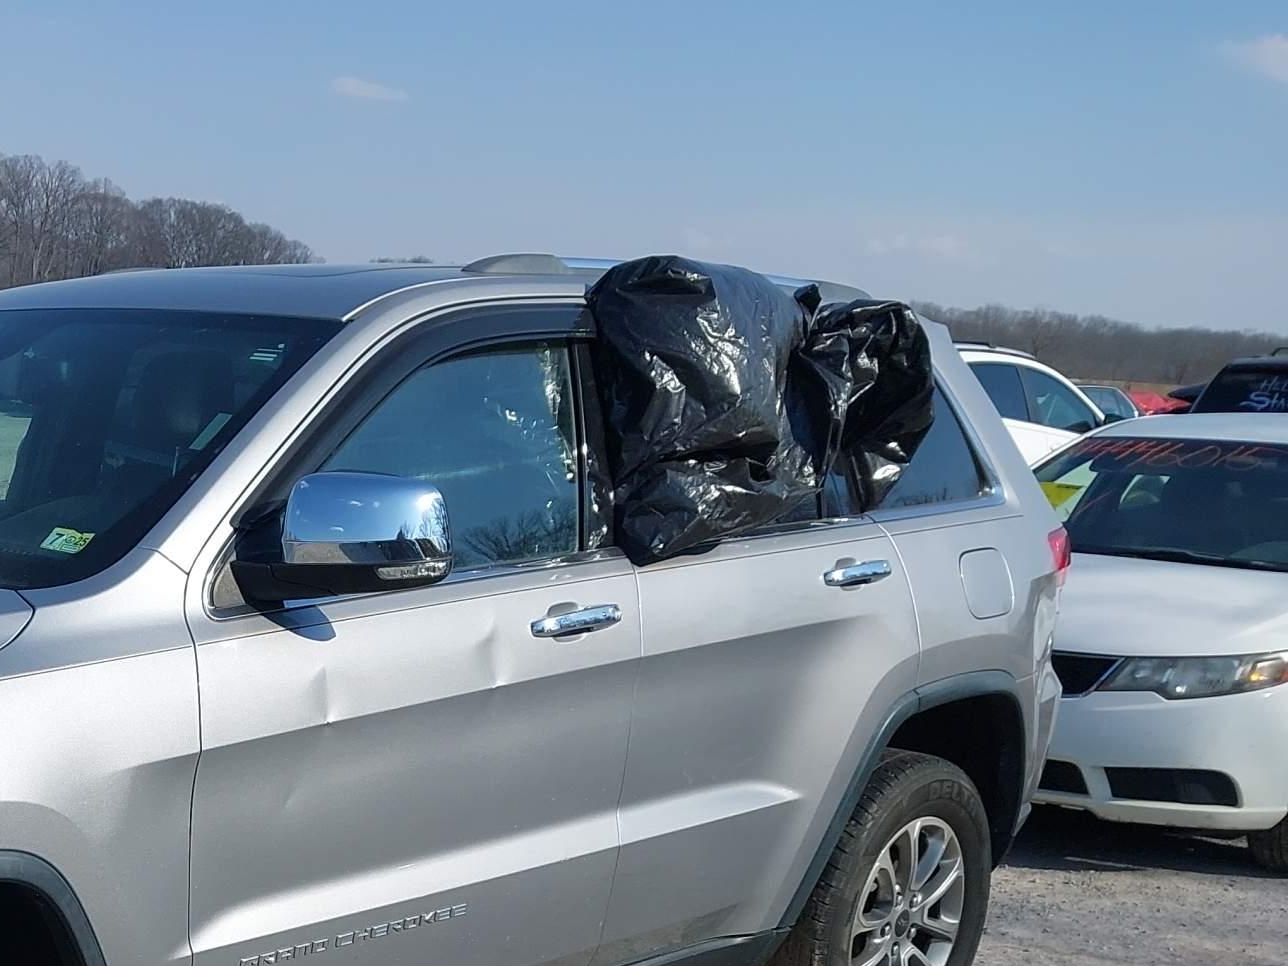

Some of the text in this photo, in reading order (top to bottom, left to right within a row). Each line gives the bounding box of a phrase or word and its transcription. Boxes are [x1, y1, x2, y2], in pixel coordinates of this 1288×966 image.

[49, 532, 90, 547] 7 25
[335, 903, 468, 948] CHEROKEE
